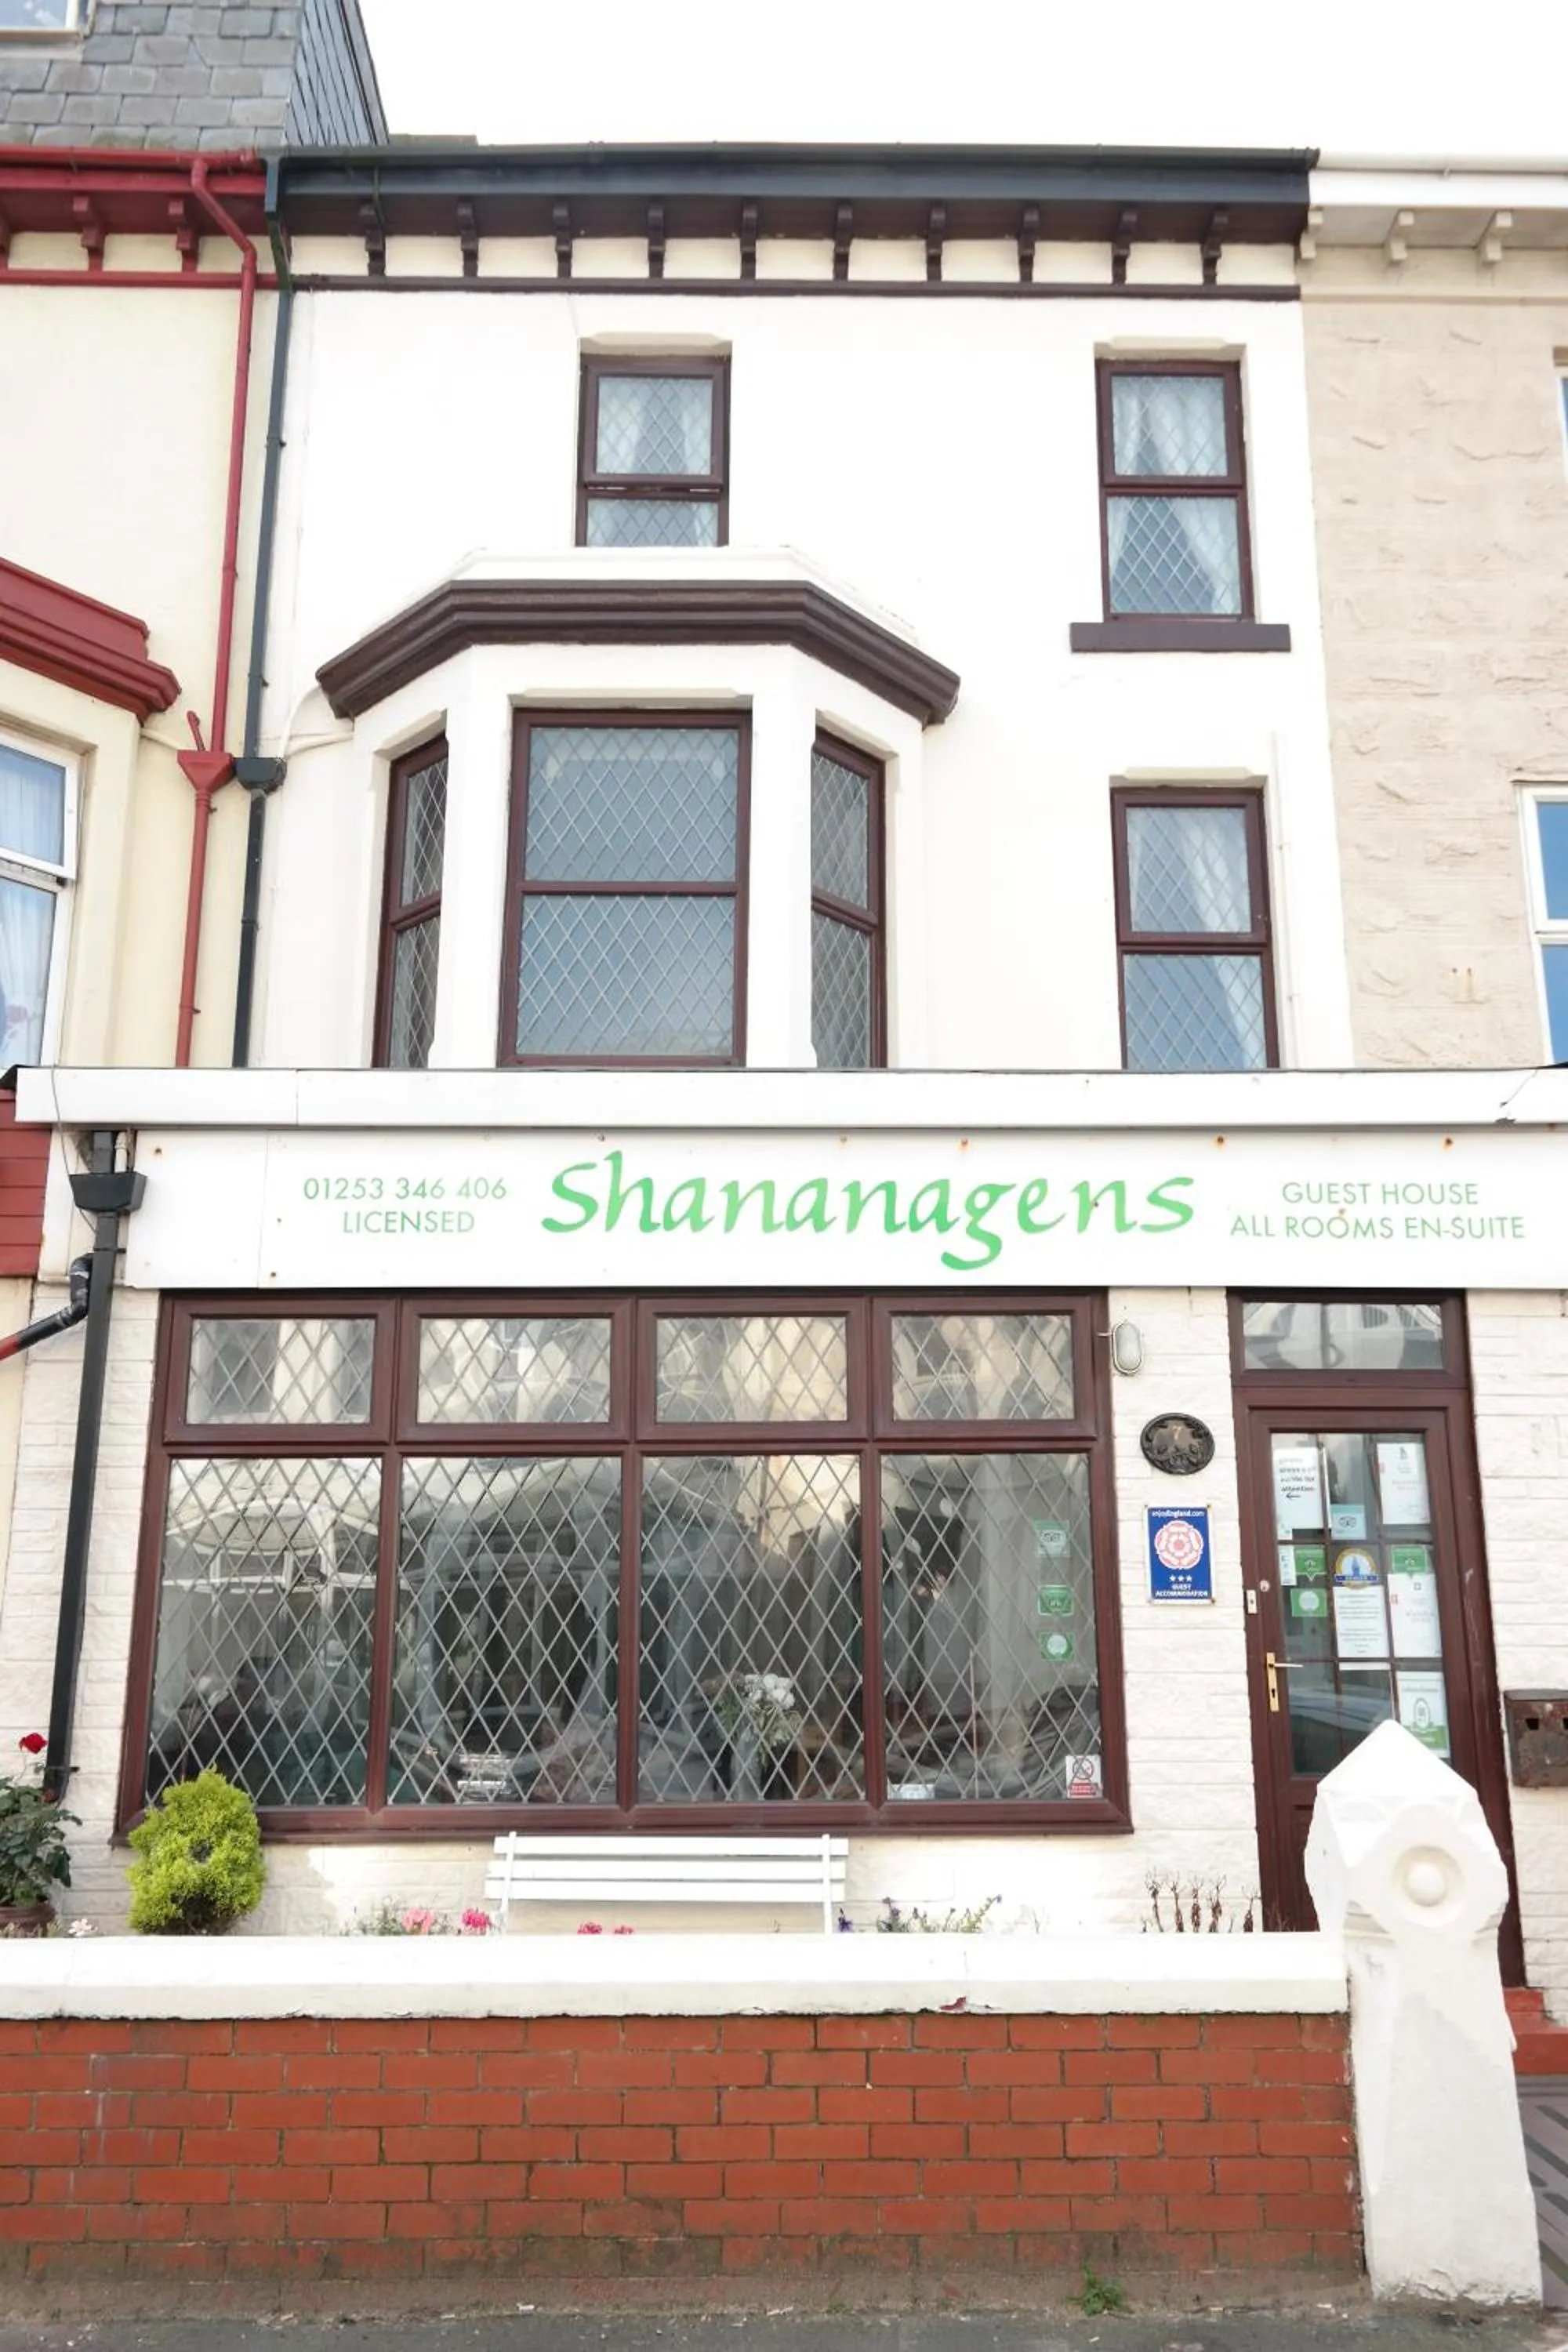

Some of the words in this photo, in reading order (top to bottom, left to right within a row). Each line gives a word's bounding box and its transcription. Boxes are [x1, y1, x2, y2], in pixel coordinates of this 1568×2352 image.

[303, 1177, 383, 1200] 01253
[395, 1177, 445, 1200] 346
[456, 1177, 507, 1200] 406
[1282, 1181, 1371, 1204] GUEST
[1381, 1182, 1479, 1205] HOUSE
[343, 1210, 475, 1234] LICENSED
[540, 1149, 1195, 1272] Shananagens
[1230, 1214, 1276, 1237] ALL
[1285, 1215, 1394, 1239] ROOMS
[1404, 1216, 1525, 1240] EN-SUITE
